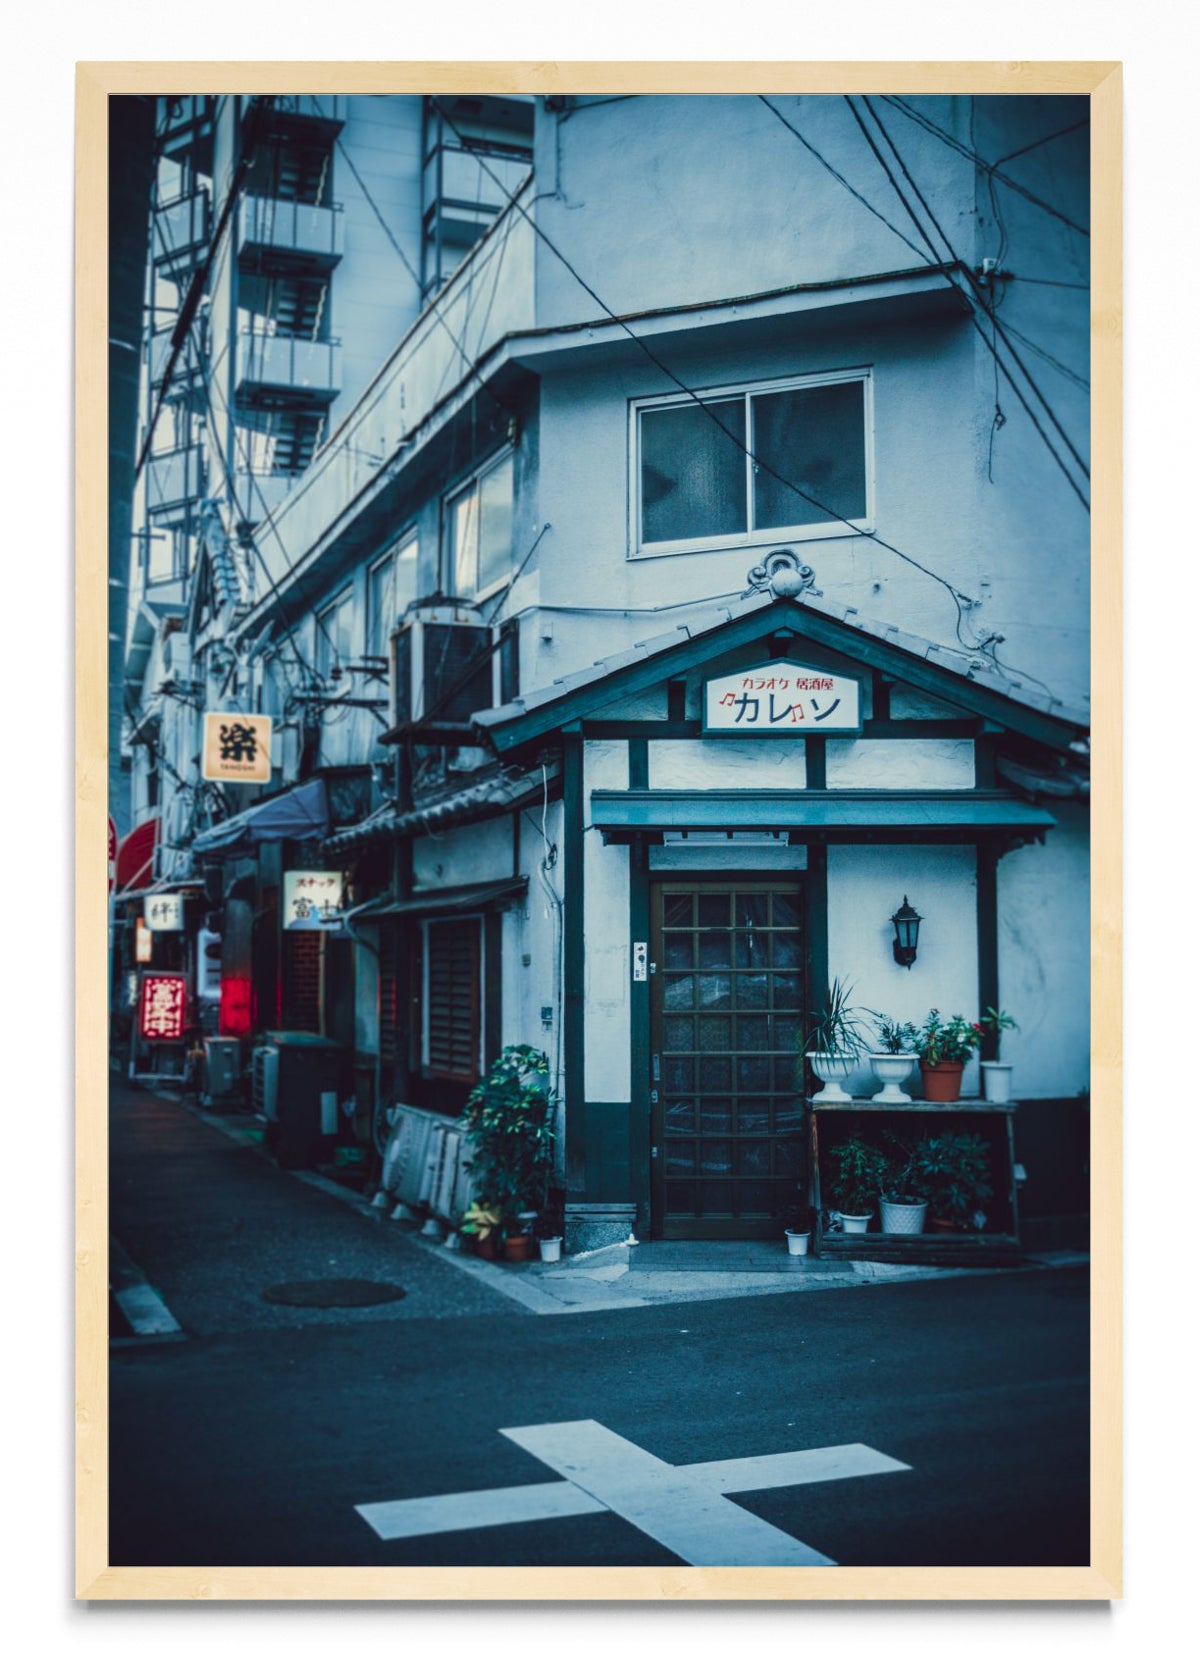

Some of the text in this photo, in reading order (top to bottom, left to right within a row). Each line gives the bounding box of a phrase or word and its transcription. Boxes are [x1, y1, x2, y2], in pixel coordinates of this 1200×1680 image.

[742, 678, 834, 691] カラオケ 居酒屋
[219, 723, 257, 762] 楽
[296, 878, 335, 888] スナック
